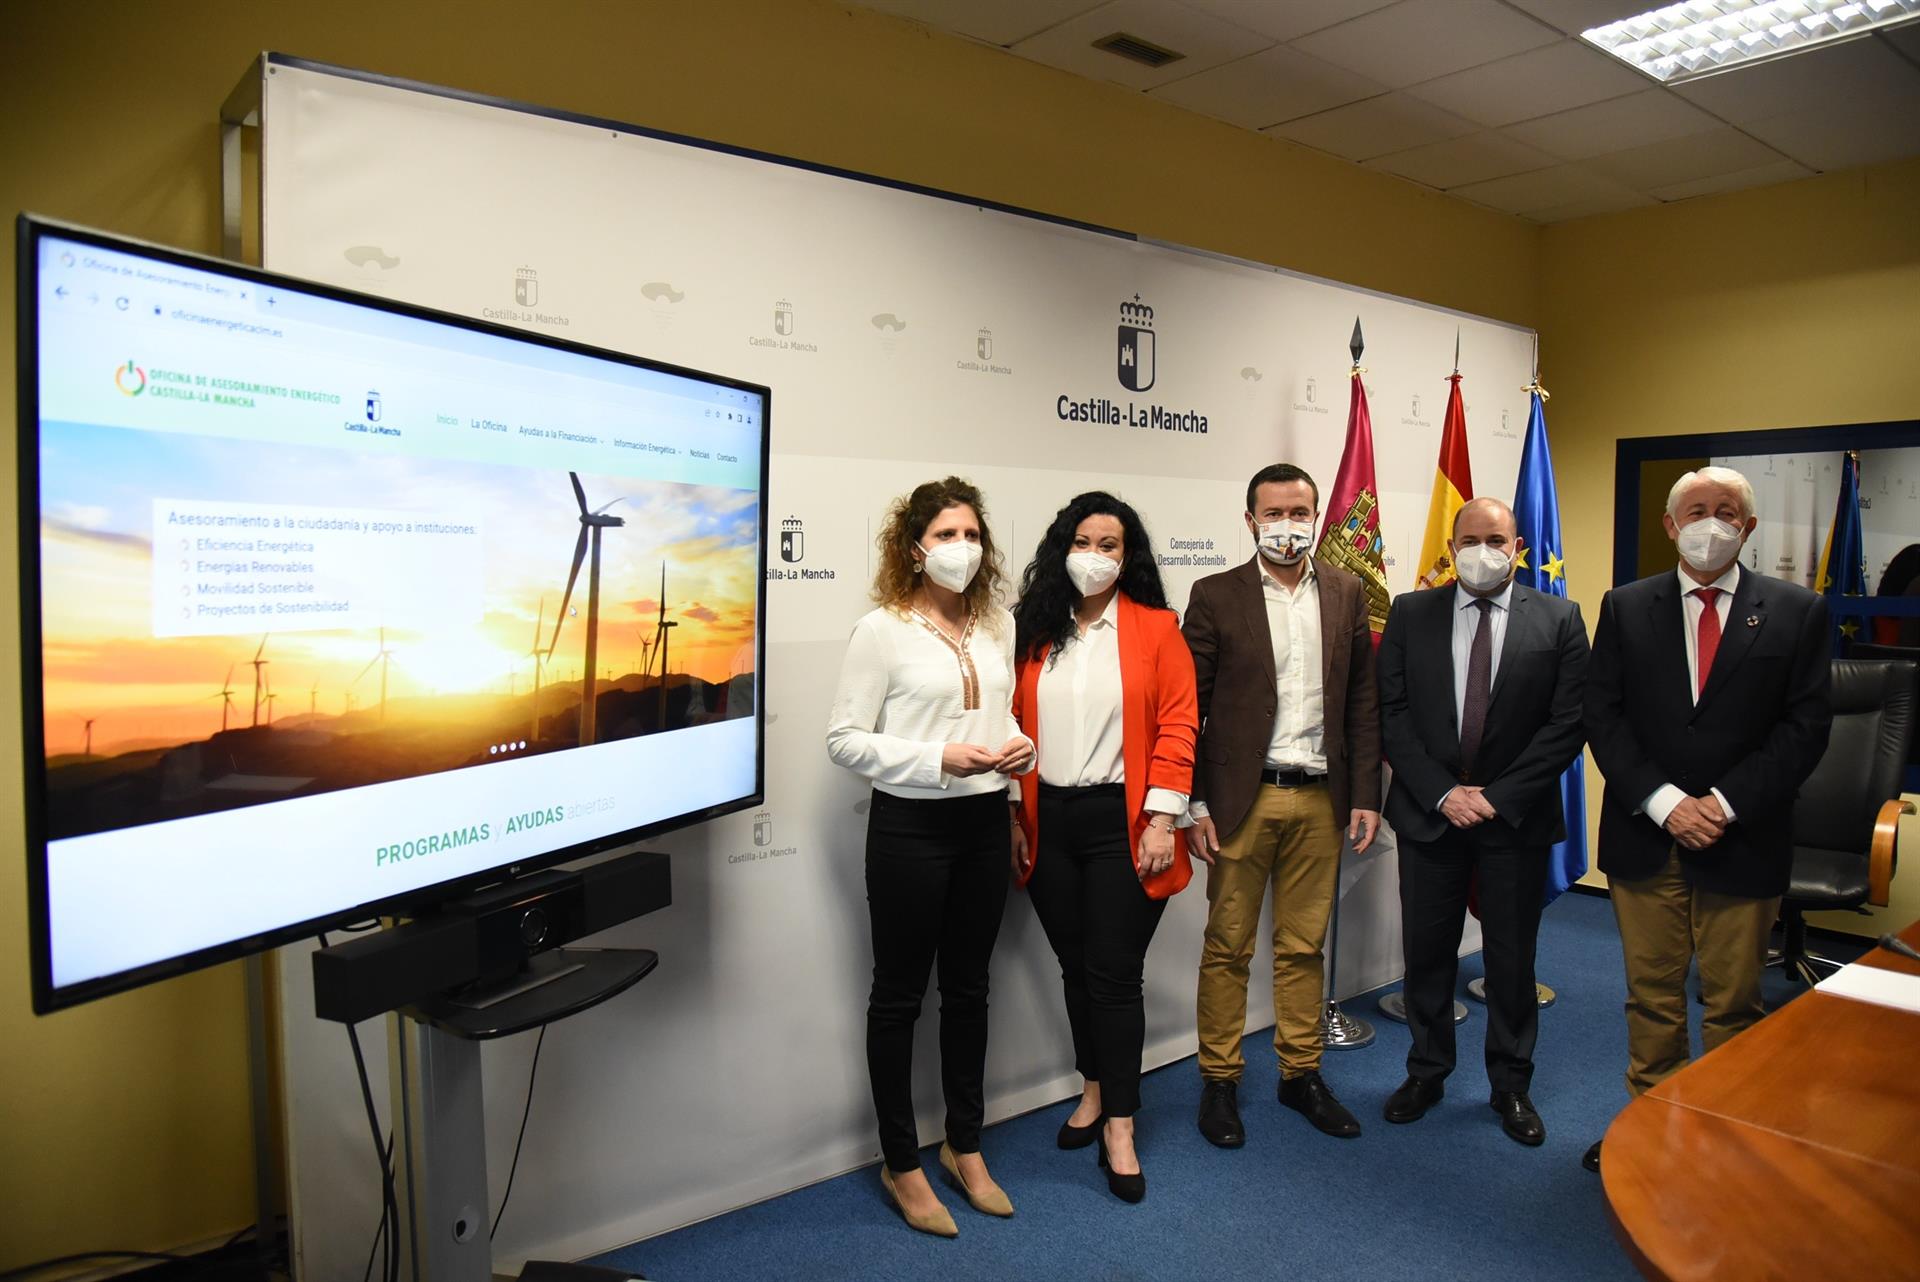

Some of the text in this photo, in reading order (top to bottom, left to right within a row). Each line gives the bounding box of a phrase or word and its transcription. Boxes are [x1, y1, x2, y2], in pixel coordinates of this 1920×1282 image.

[482, 307, 569, 326] Castilla-La Mancha
[749, 336, 818, 353] Castilla-La Mancha
[150, 368, 341, 405] OFICINA DE ASESORAMIENTO ENERGÉTICO
[150, 385, 255, 409] CASTILLA-LA MANCHA
[436, 413, 459, 427] Inicio
[471, 418, 508, 433] La Oficina
[1151, 405, 1208, 433] Mancha
[519, 425, 544, 440] Ayudas
[551, 429, 557, 440] la
[558, 430, 597, 445] Financiación
[614, 438, 647, 452] Información
[690, 449, 710, 460] Noticias
[716, 452, 738, 464] Contacto
[168, 511, 478, 536] Asesoramiento a la ciudadanía y apoyo a instituciones:
[197, 537, 314, 554] Eficiencia Energética
[1170, 537, 1214, 552] Consejería de
[197, 560, 314, 575] Energías Renovables
[1157, 553, 1227, 567] Desarrollo Sostenible
[801, 568, 835, 580] Mancha
[197, 581, 314, 595] Movilidad Sostenible
[197, 600, 349, 618] Proyectos de Sostenibilidad
[375, 822, 490, 867] PROGRAMAS
[505, 805, 564, 836] AYUDAS
[567, 794, 616, 821] abiertas
